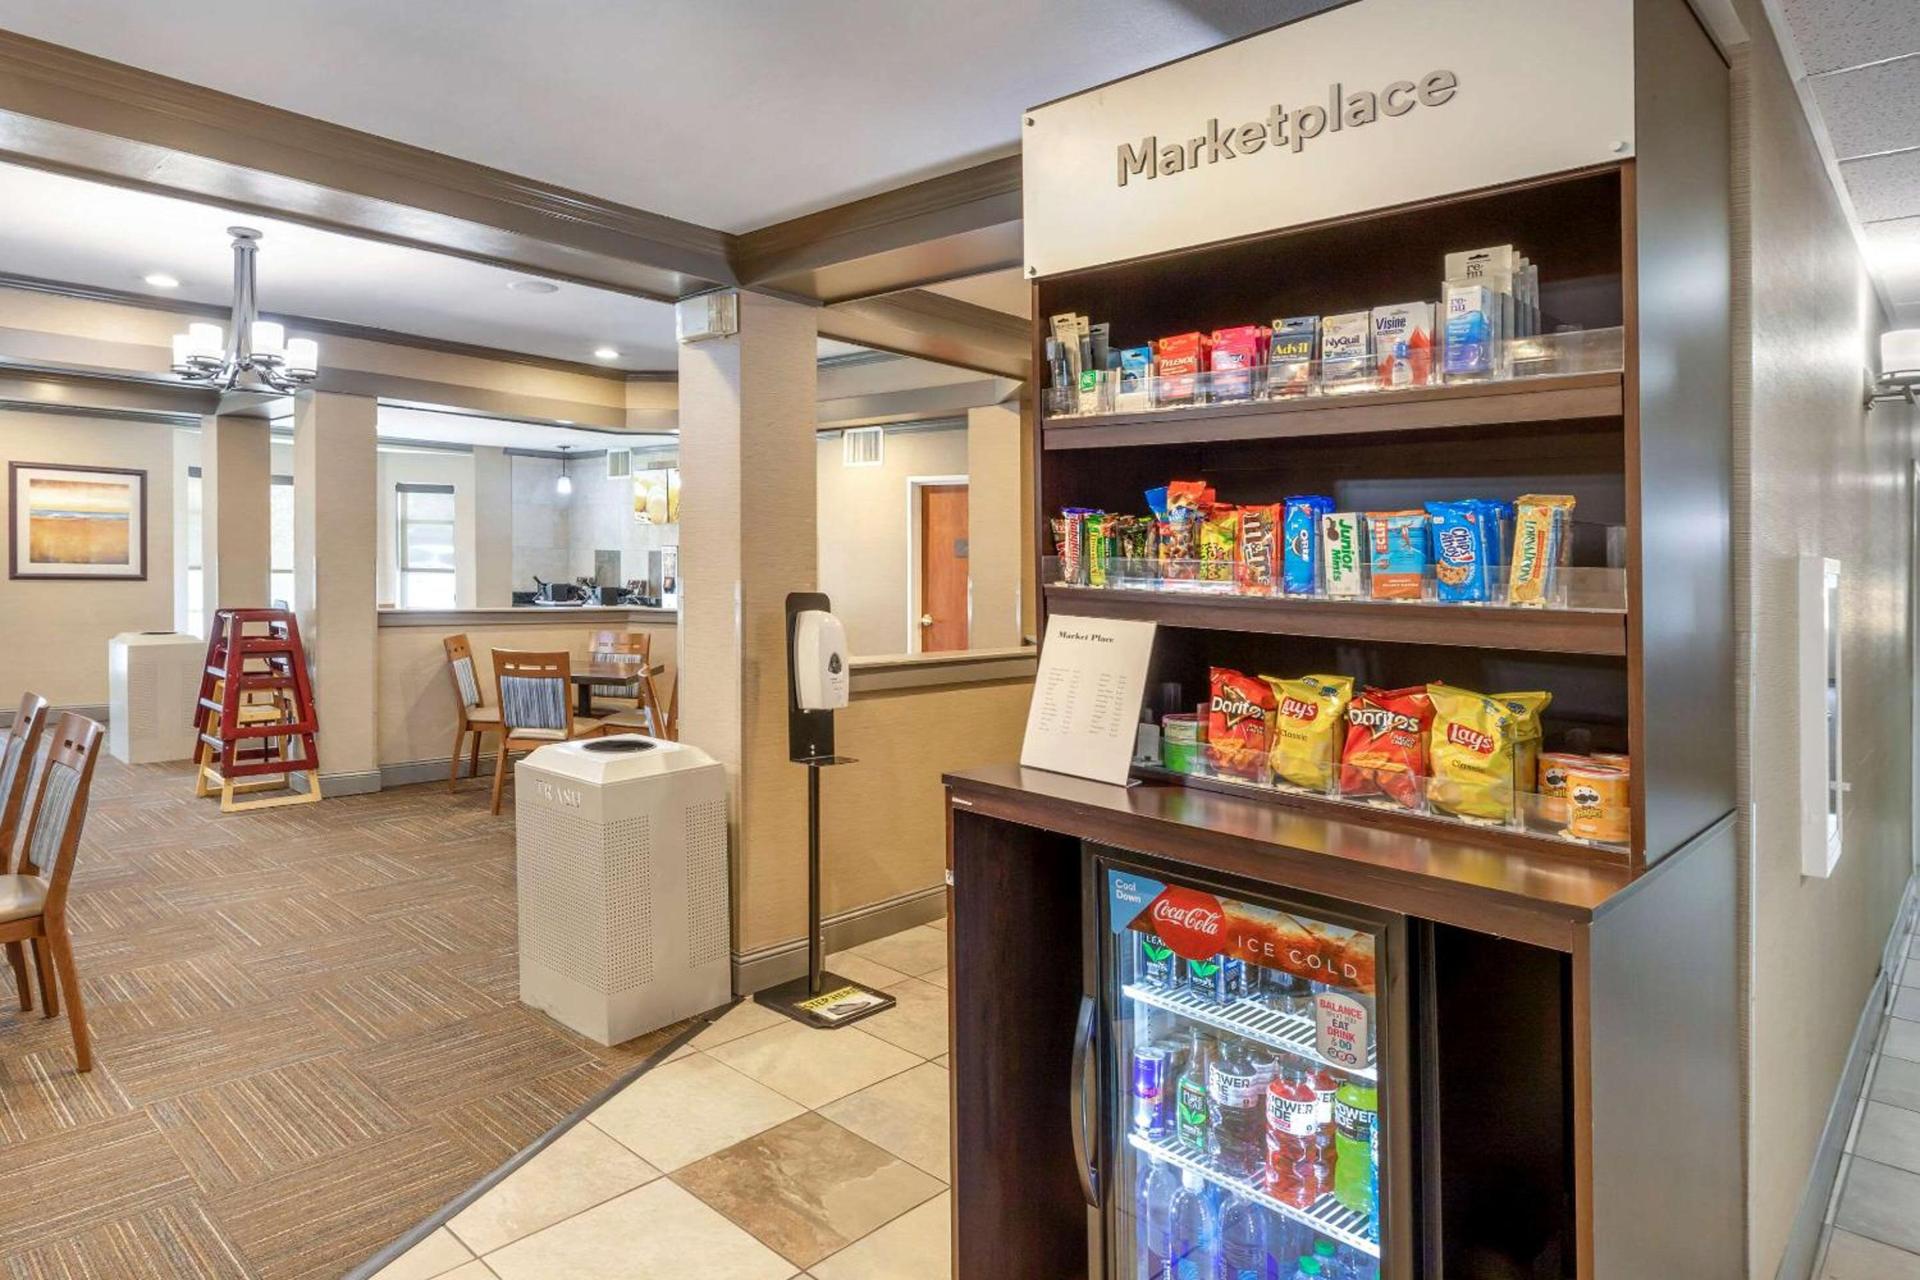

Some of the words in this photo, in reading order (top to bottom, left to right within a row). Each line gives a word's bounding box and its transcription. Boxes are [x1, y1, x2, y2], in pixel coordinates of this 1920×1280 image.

[1117, 68, 1458, 187] Marketplace
[1376, 317, 1407, 330] Visine
[1273, 343, 1308, 356] Advil
[1339, 519, 1355, 572] Junior
[1452, 528, 1471, 556] Chips
[1331, 549, 1342, 582] Mints
[1058, 631, 1088, 641] Market
[1091, 634, 1114, 643] Place
[1350, 709, 1420, 733] Doritos
[1115, 879, 1136, 892] Cool
[1116, 889, 1141, 904] Down
[1153, 898, 1219, 935] Coca-Cola
[1238, 935, 1275, 958] ICE
[1290, 951, 1357, 979] COLD
[1319, 999, 1362, 1020] BALANCE
[1327, 1026, 1355, 1043] DRINK
[1332, 1019, 1350, 1031] EAT
